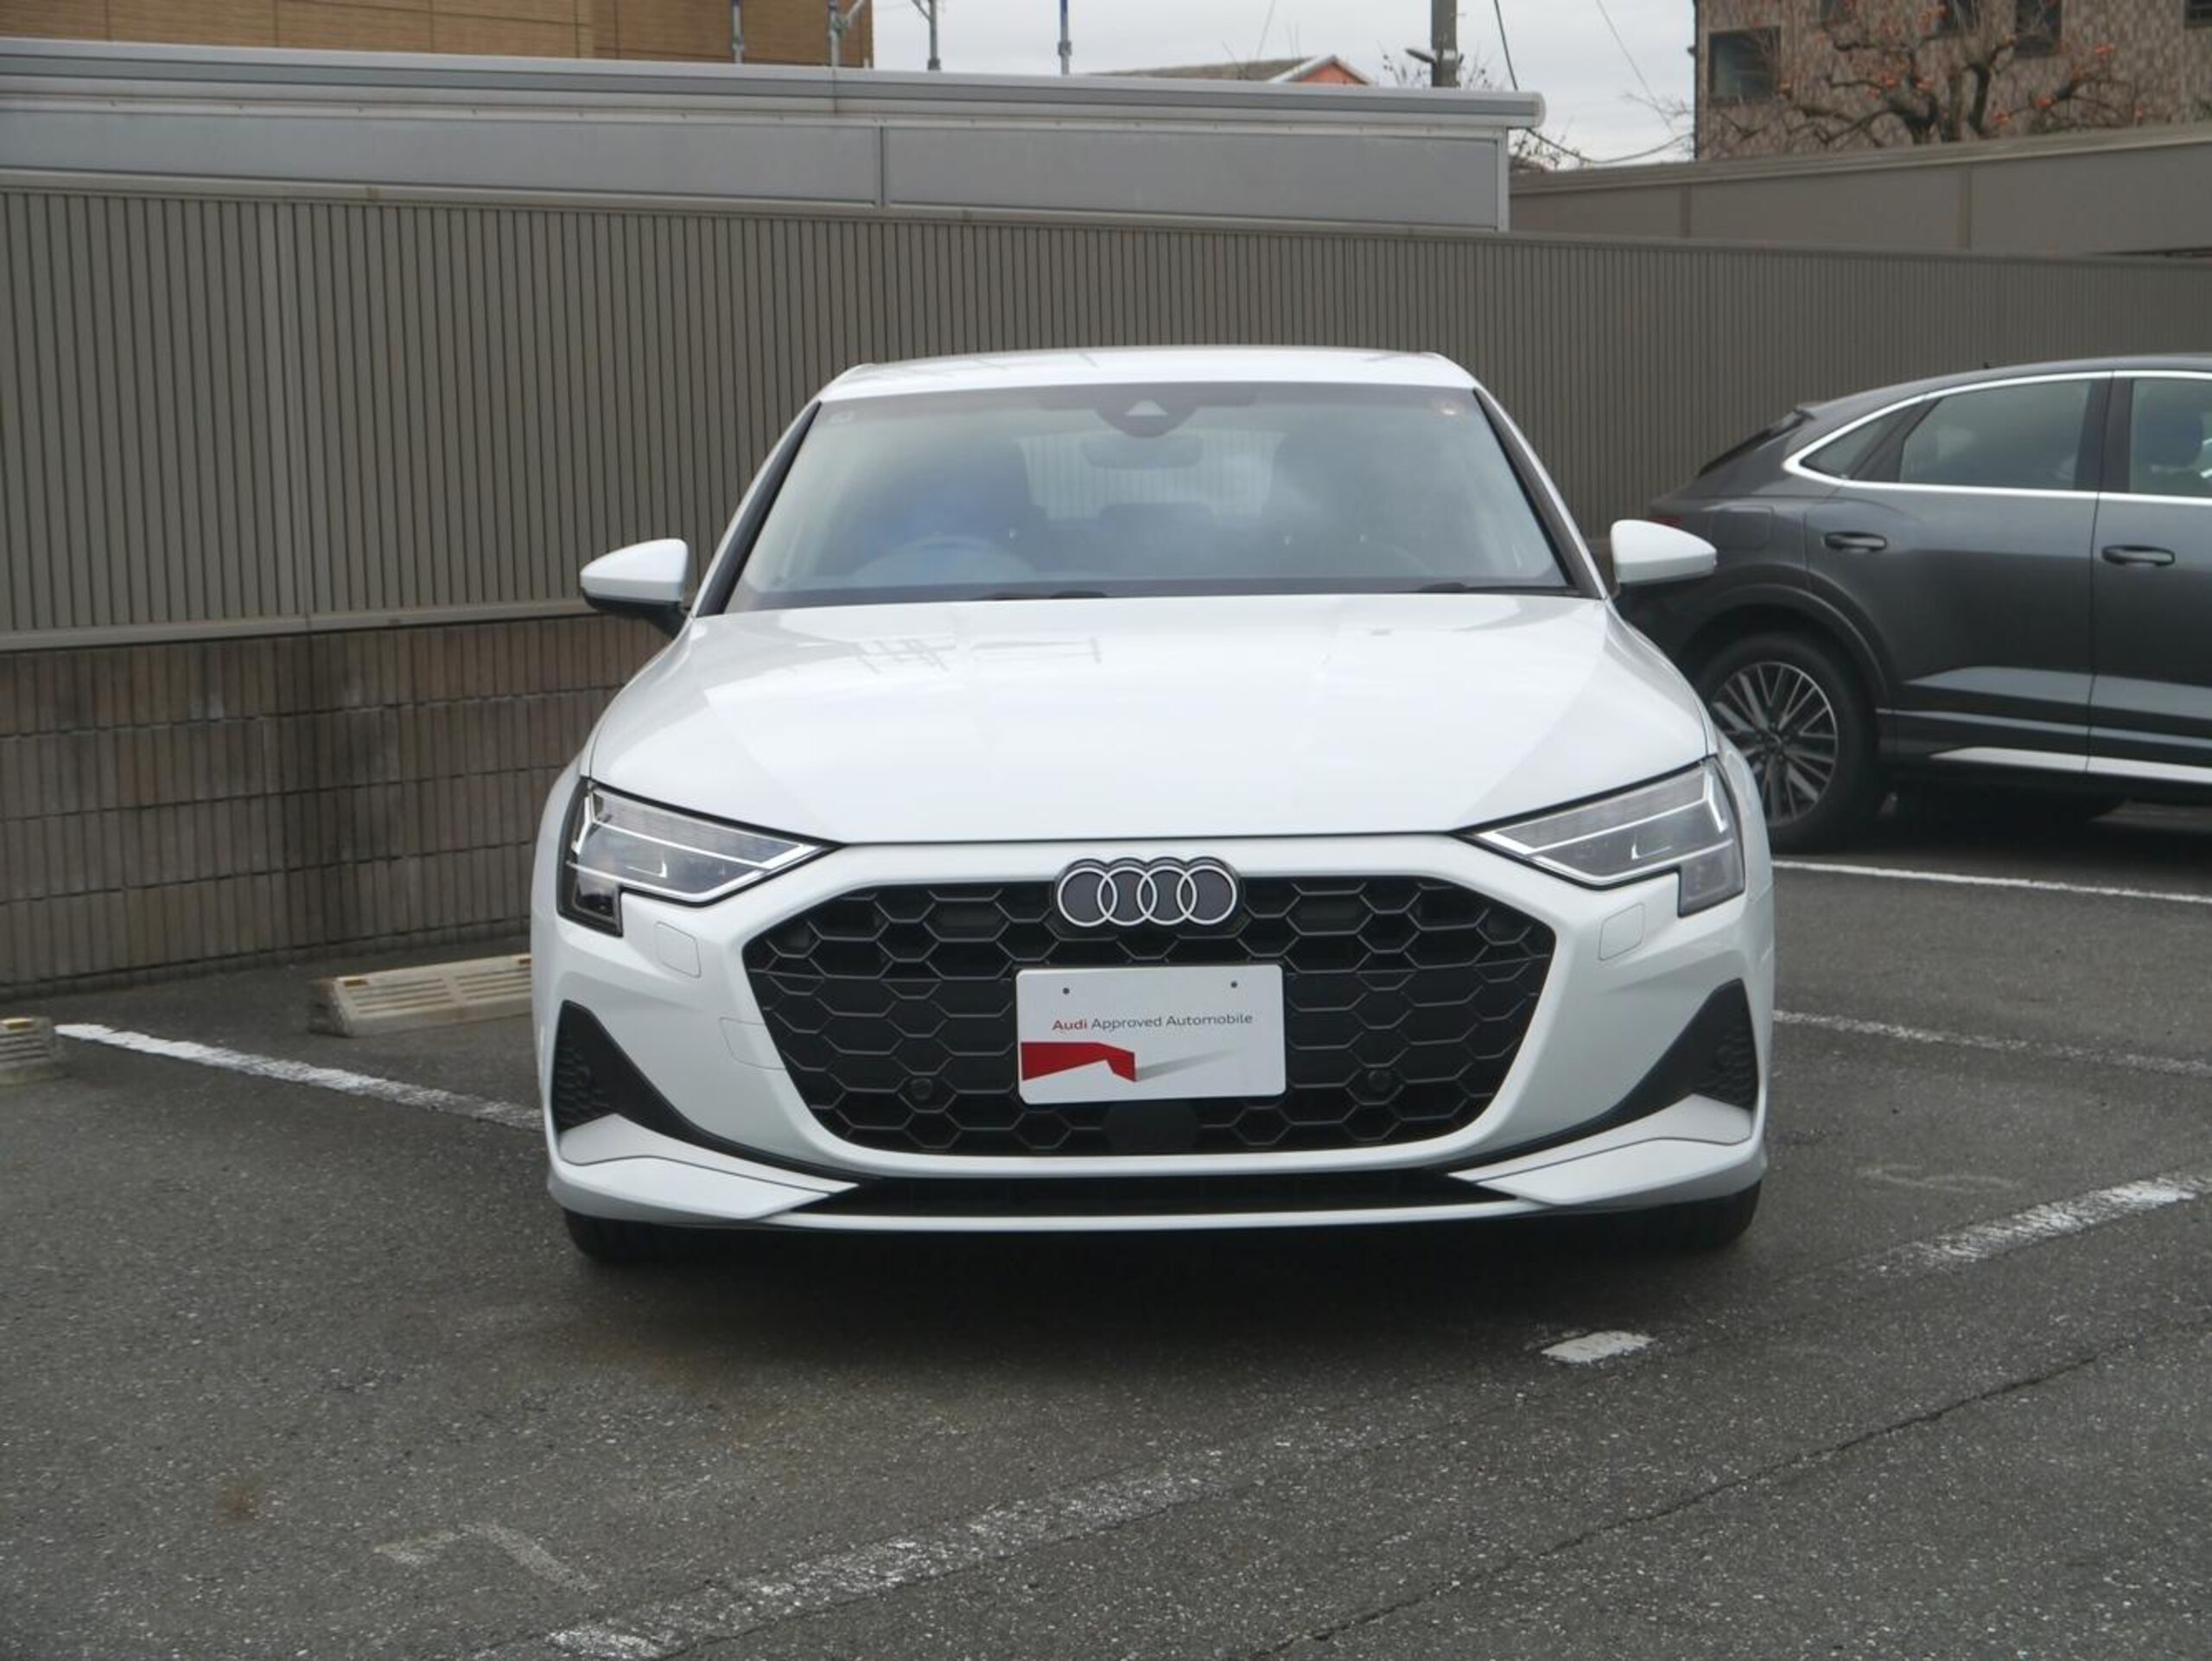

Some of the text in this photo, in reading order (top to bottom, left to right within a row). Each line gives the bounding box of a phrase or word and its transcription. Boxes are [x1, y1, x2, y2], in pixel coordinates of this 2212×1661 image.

[1052, 1014, 1253, 1032] Audi Approved Automobile
